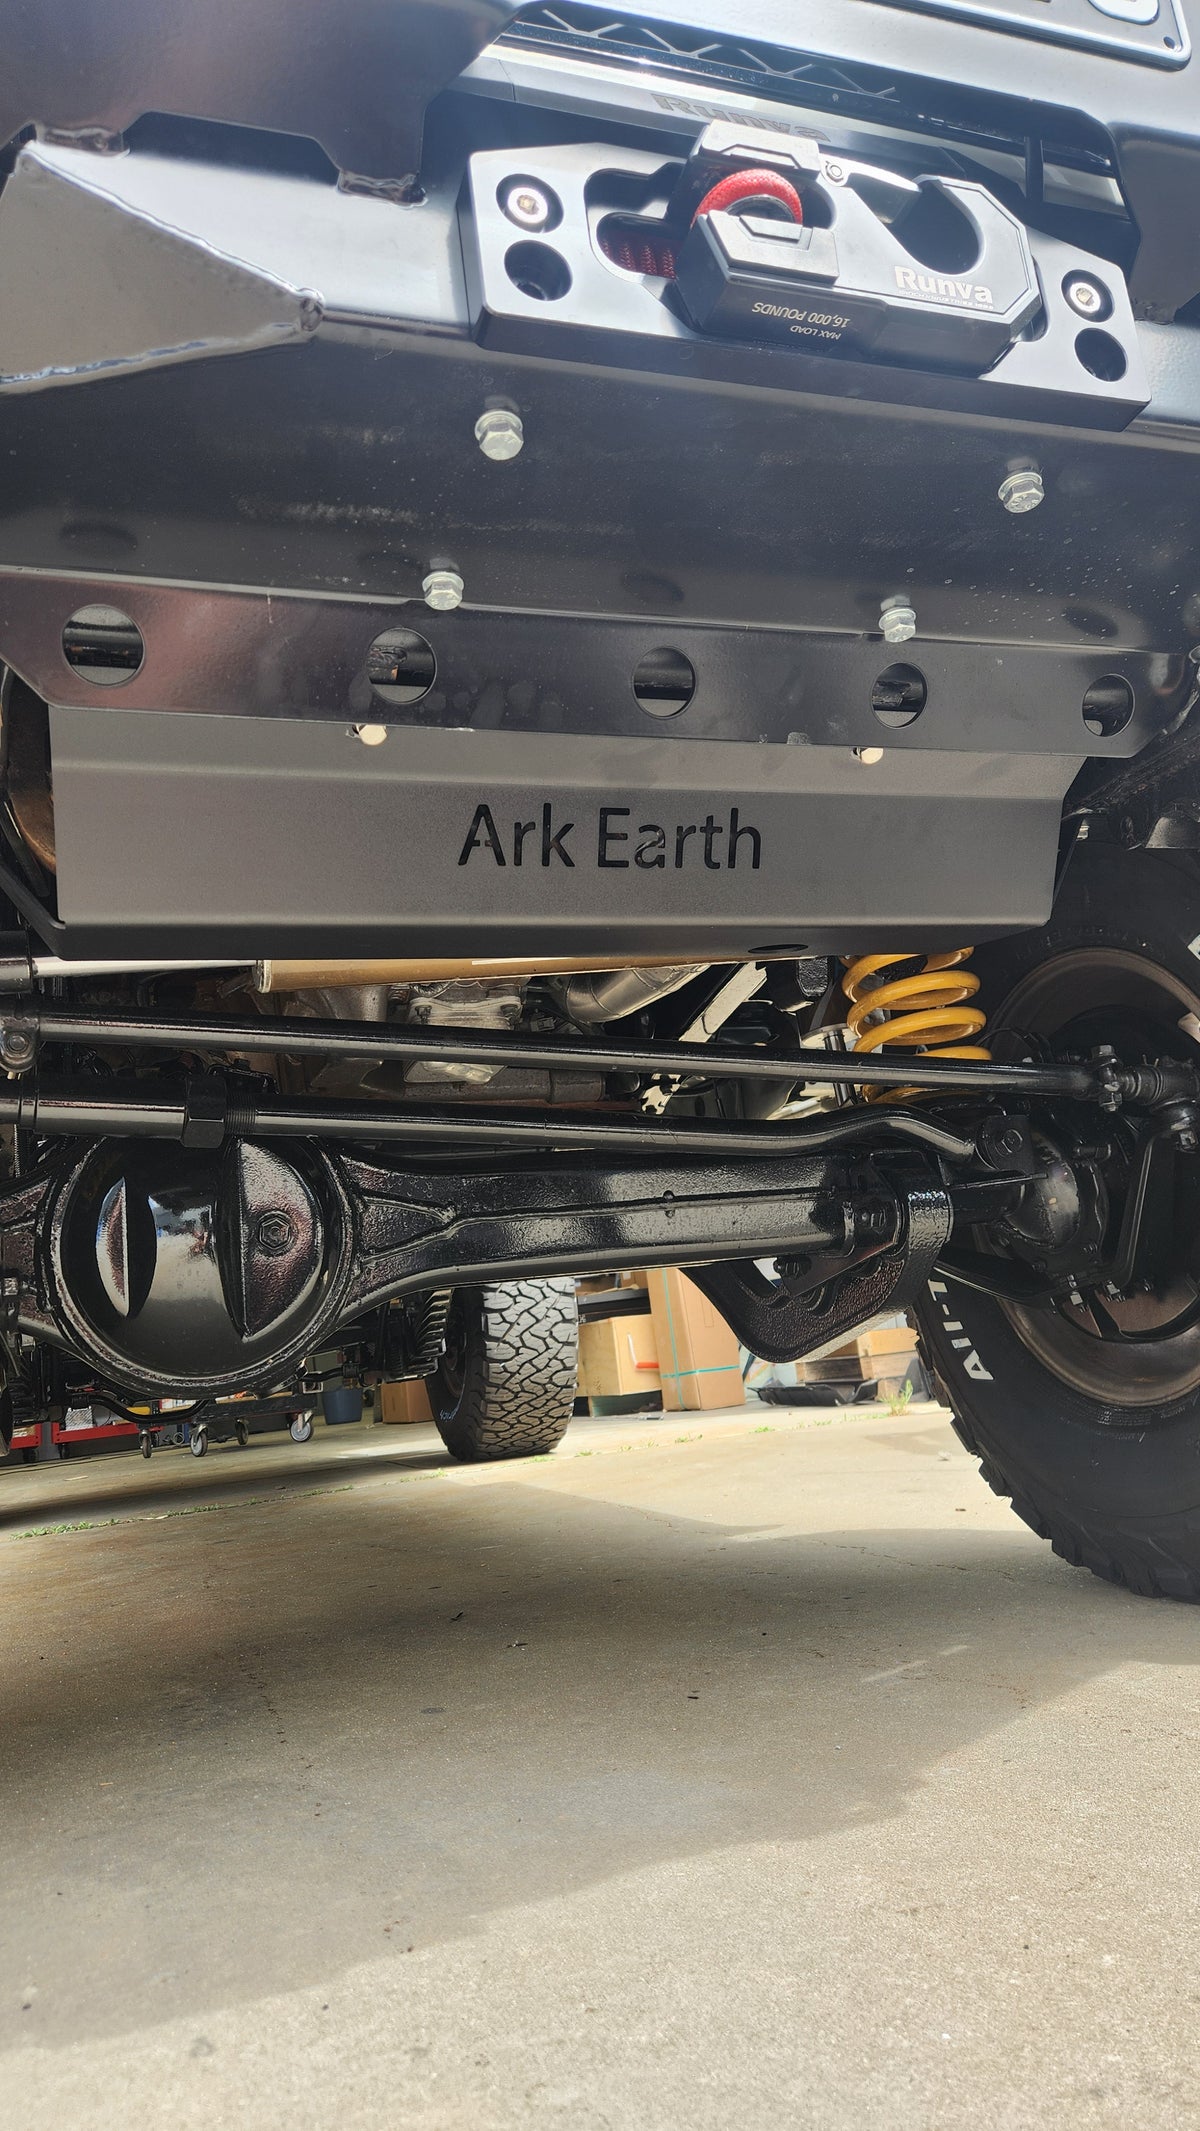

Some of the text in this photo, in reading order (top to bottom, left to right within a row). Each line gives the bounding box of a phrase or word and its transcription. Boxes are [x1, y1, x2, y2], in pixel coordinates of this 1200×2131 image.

[894, 265, 993, 304] Runva
[752, 302, 850, 328] 16,000 POUNDS
[790, 325, 841, 340] MAX LOAD
[458, 802, 762, 870] Ark Earth
